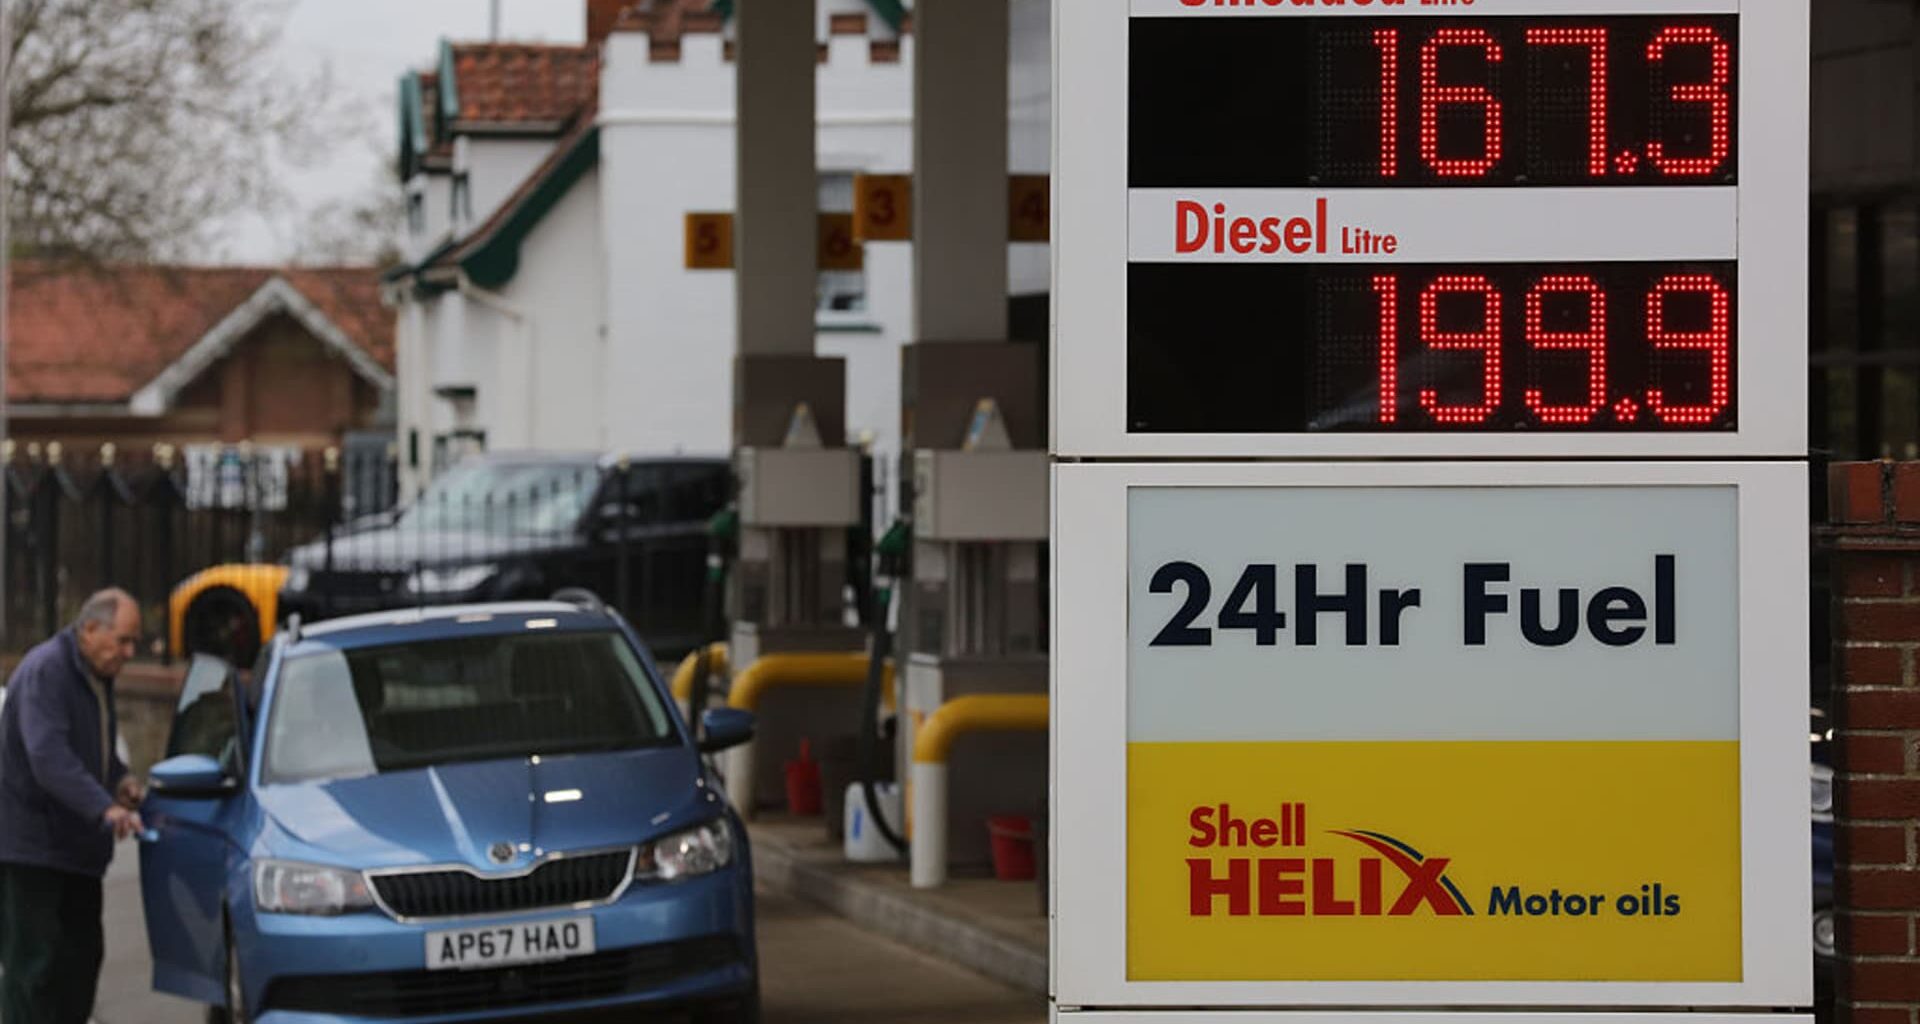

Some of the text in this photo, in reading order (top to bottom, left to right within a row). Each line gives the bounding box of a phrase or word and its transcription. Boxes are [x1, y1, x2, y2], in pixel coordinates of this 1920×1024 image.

[1373, 25, 1730, 177] 167.3
[870, 189, 896, 226] 3
[1018, 189, 1046, 227] 4
[1175, 197, 1398, 255] Diesel Litre
[695, 221, 719, 255] 5
[1373, 273, 1730, 425] 199.9
[1148, 554, 1676, 647] 24Hr Fuel
[1188, 802, 1306, 848] Shell
[1186, 857, 1465, 916] HELIX
[1488, 884, 1681, 917] Motor oils
[440, 928, 514, 962] AP67
